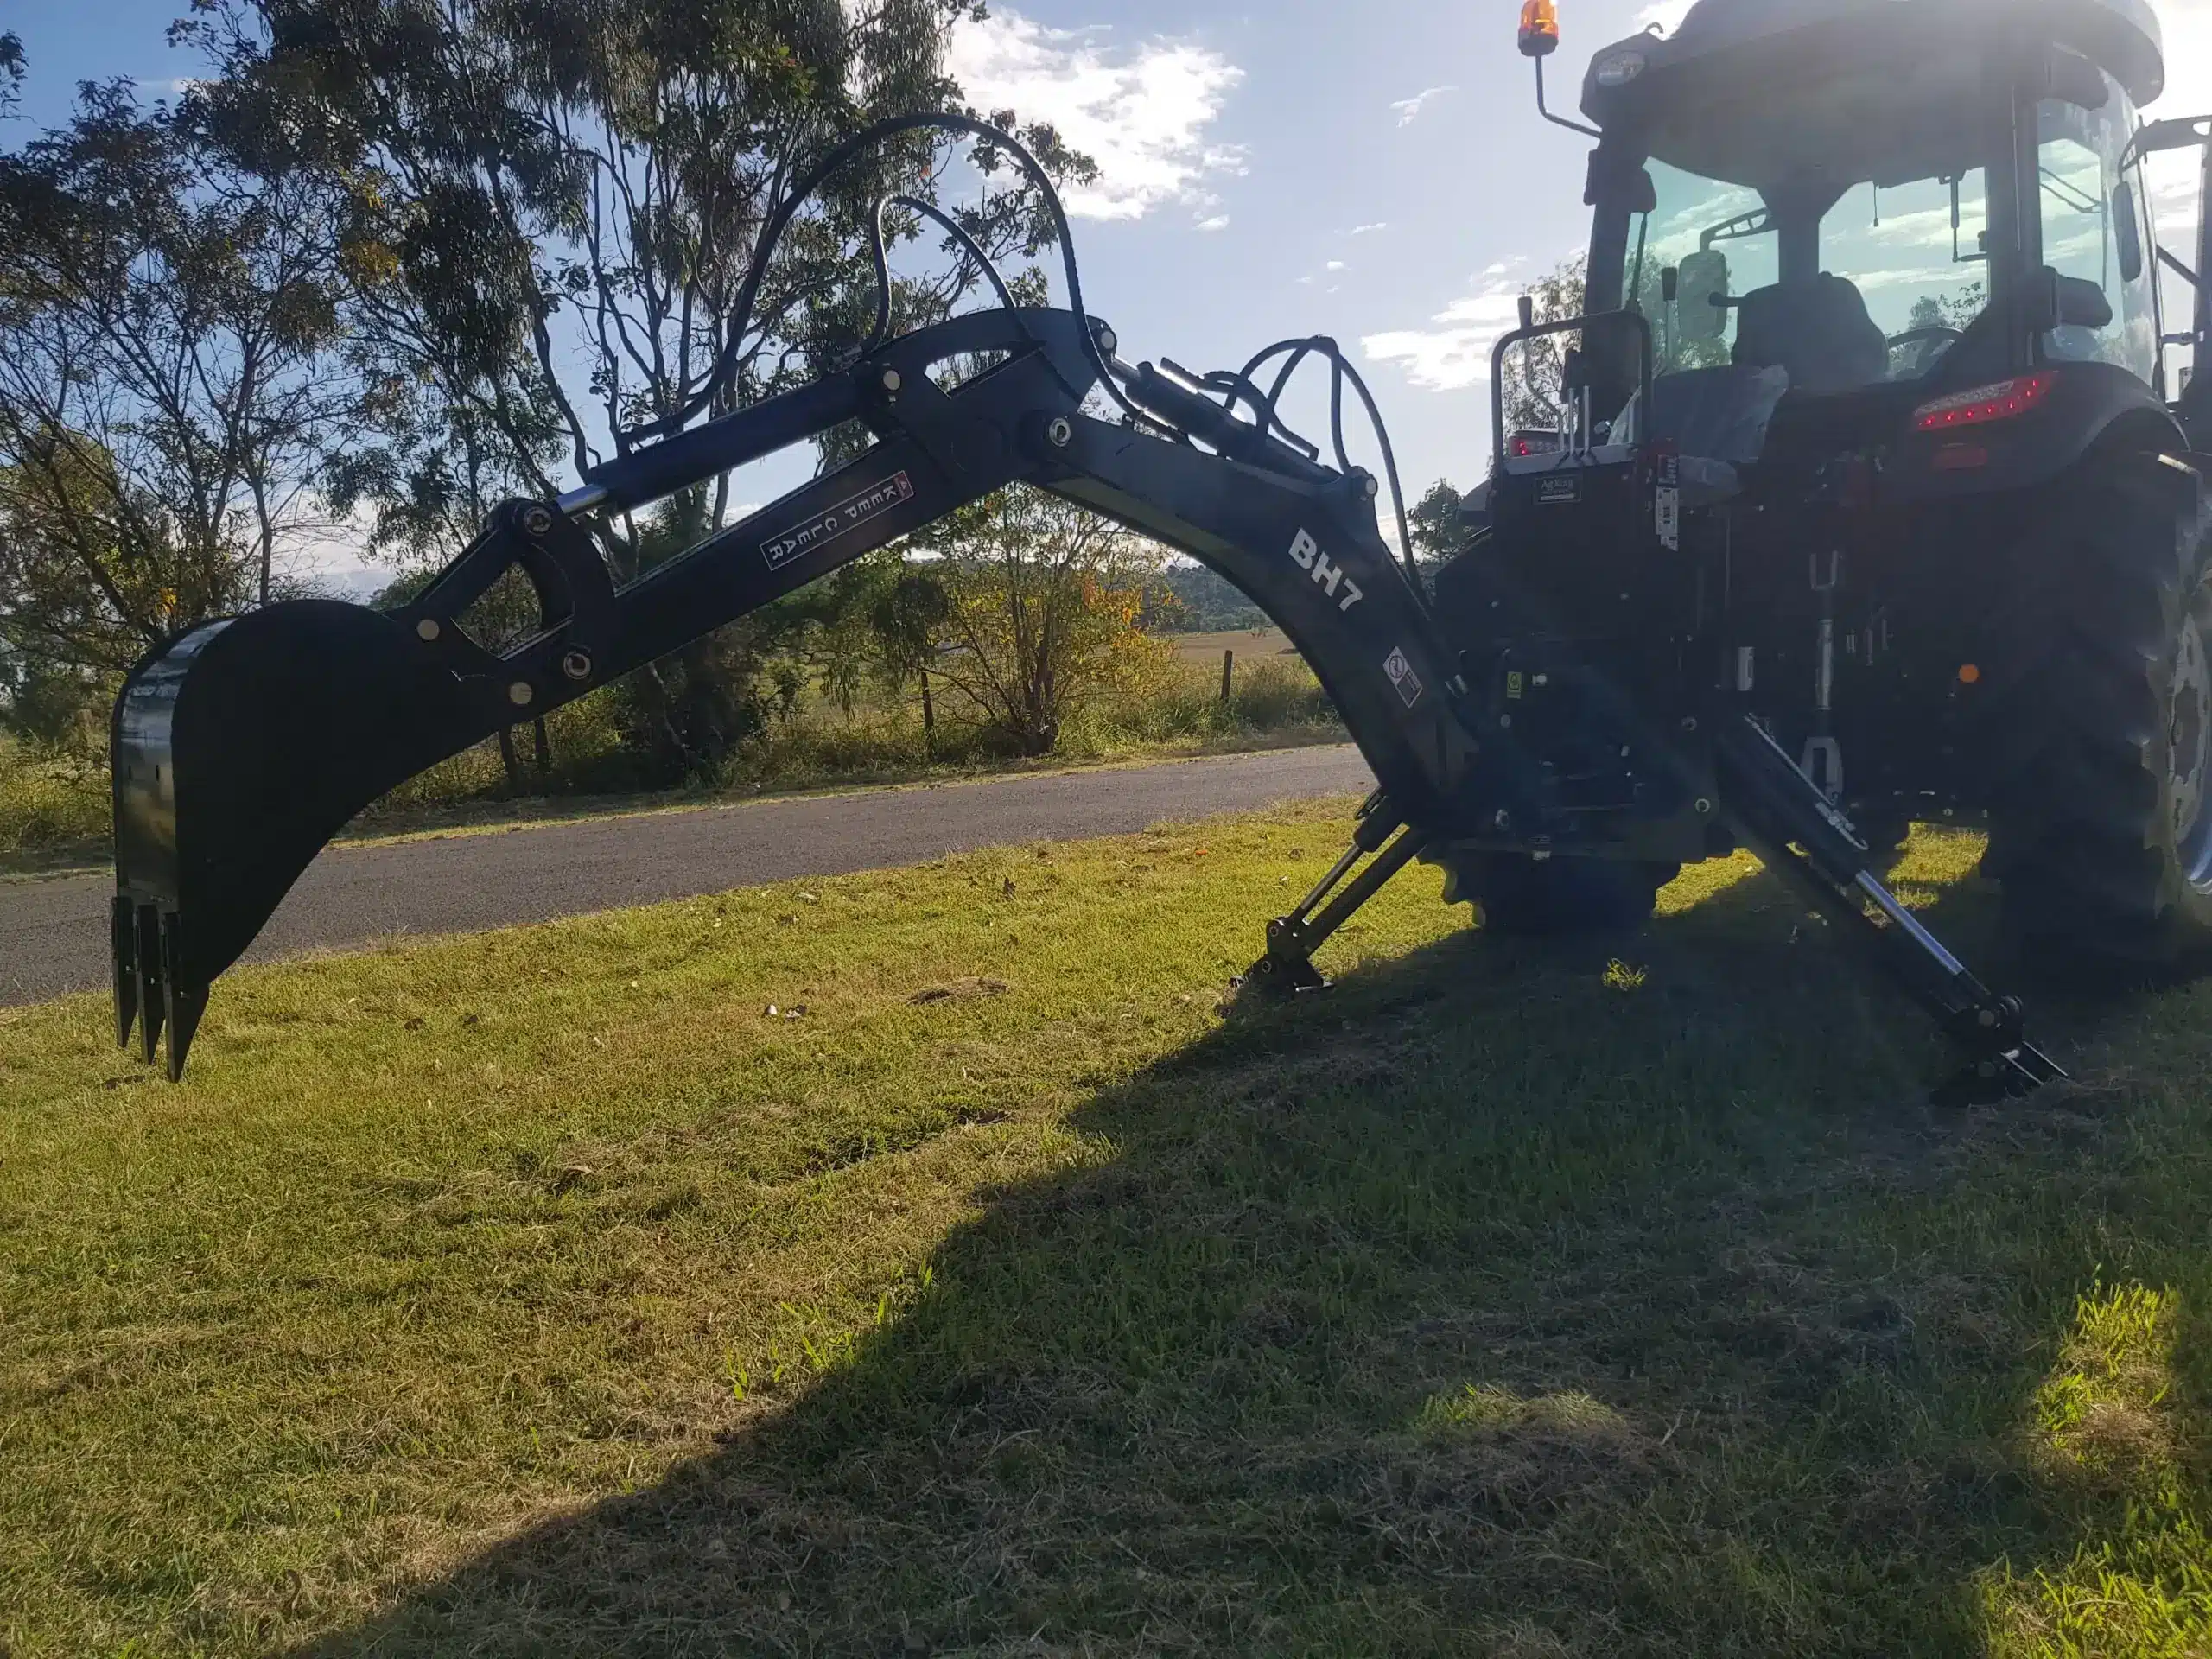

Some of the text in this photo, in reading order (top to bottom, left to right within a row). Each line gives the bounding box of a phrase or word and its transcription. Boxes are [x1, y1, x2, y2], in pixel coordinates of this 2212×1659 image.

[769, 485, 897, 561] KEEP CLEAR
[1288, 527, 1363, 612] BH7
